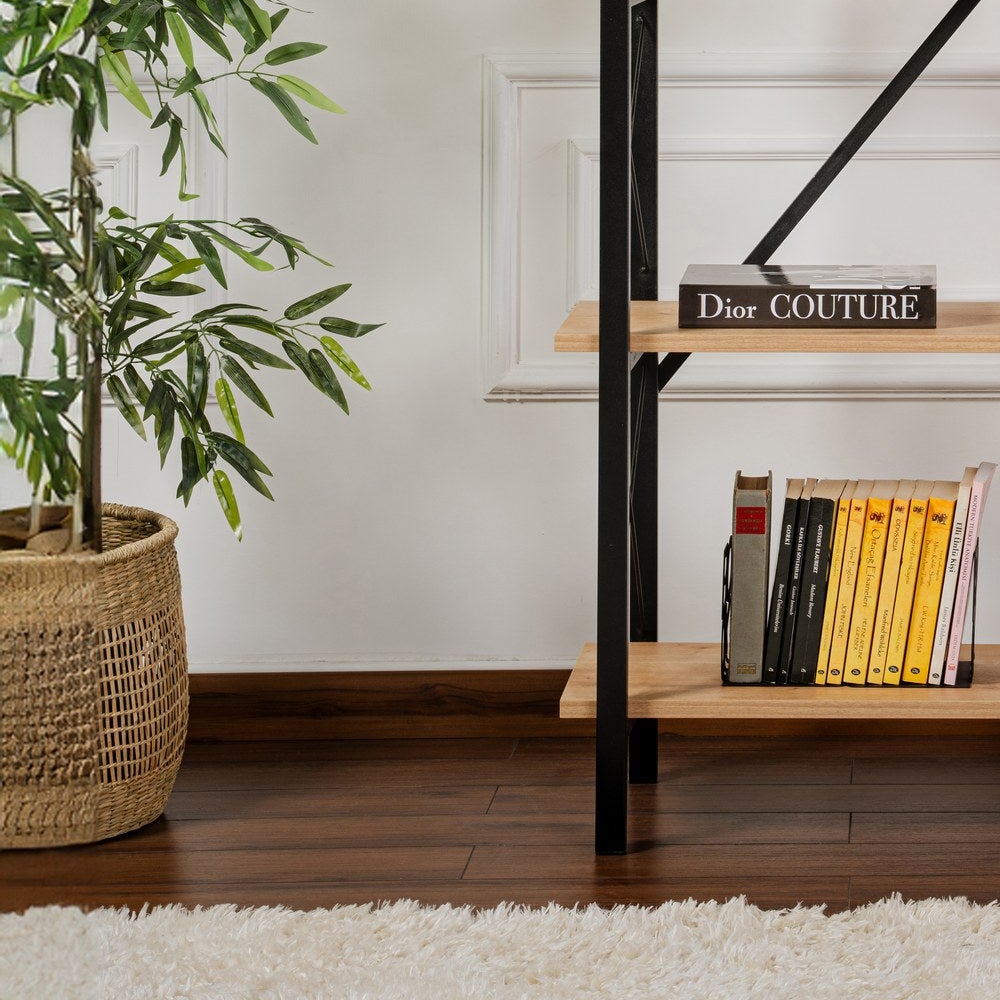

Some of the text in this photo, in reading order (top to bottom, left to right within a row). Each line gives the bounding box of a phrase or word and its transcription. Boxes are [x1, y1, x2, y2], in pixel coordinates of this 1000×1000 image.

[697, 293, 919, 320] Dior COUTURE
[952, 537, 962, 557] Ünlü
[813, 548, 821, 574] FLAUBERT
[845, 561, 855, 586] England
[949, 558, 957, 573] Kişi
[862, 565, 876, 608] Efsaneleri
[840, 604, 848, 621] JOHN
[881, 609, 891, 634] Manfred
